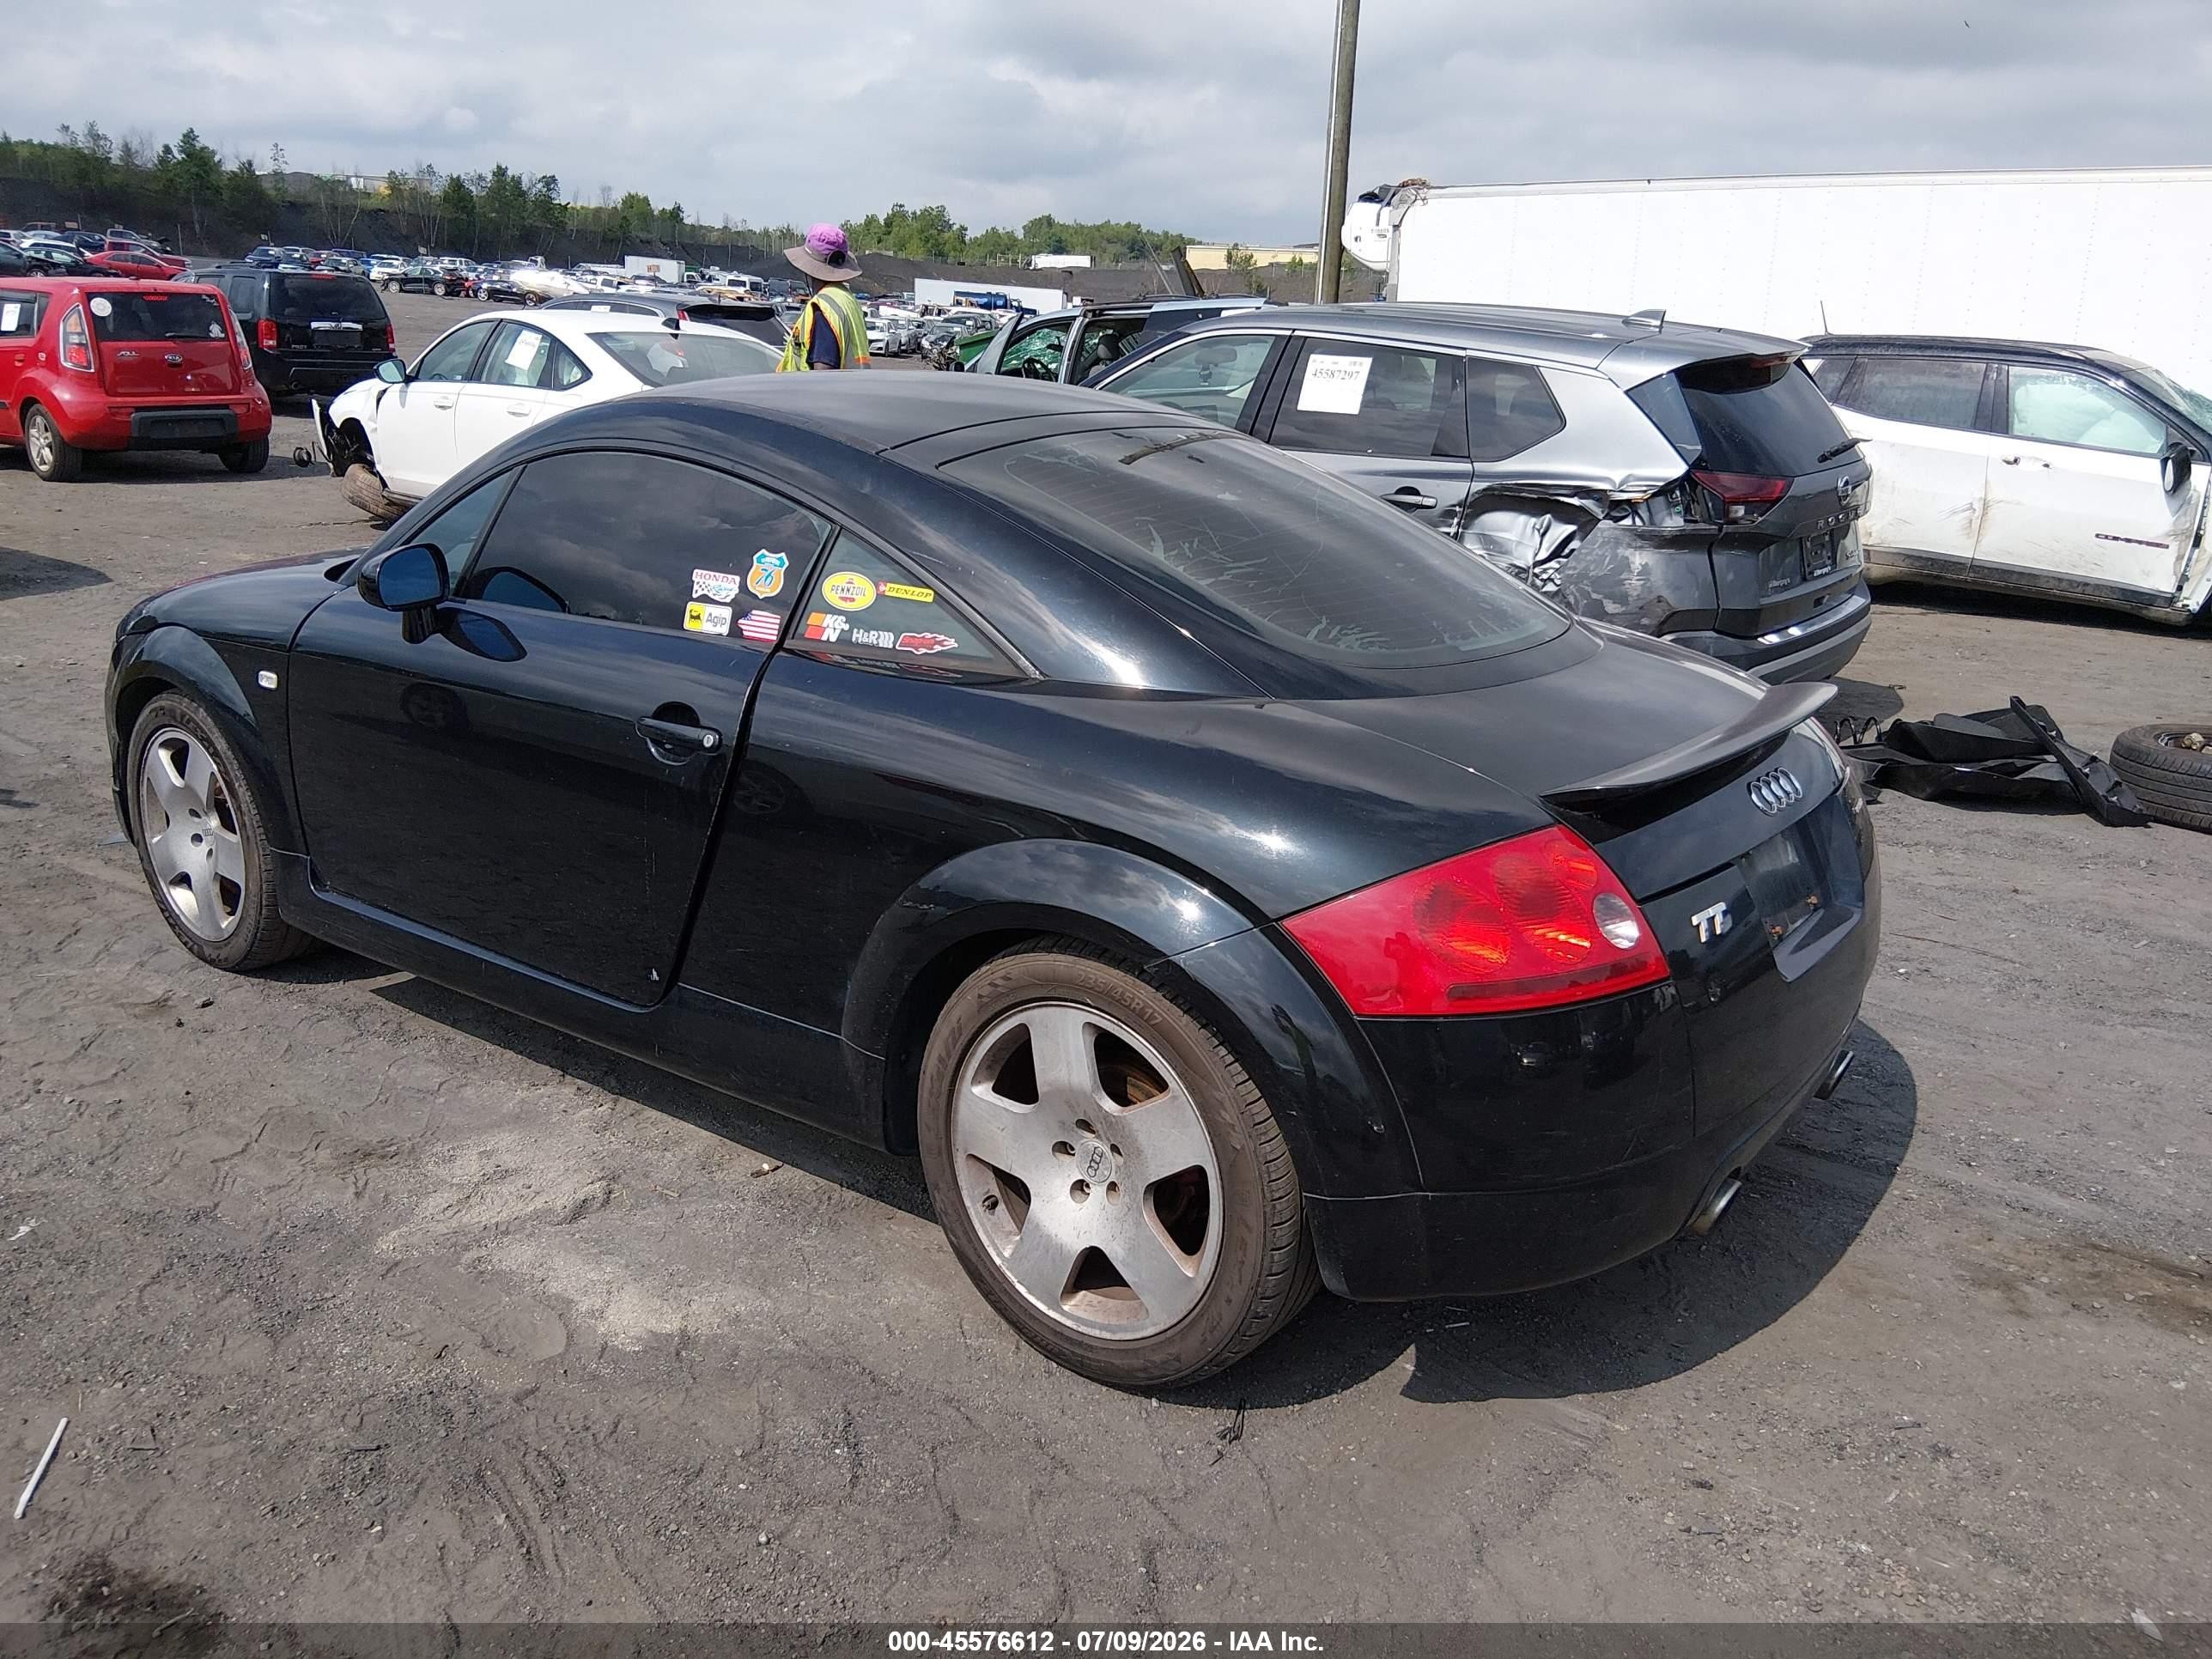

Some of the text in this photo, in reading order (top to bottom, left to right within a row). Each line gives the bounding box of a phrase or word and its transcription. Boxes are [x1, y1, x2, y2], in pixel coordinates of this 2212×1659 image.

[694, 570, 738, 586] HONDA
[756, 567, 775, 587] 76
[830, 584, 866, 598] PENNZOIL
[887, 586, 933, 599] DUNLOP
[705, 611, 727, 628] Agip
[1691, 901, 1727, 943] TT
